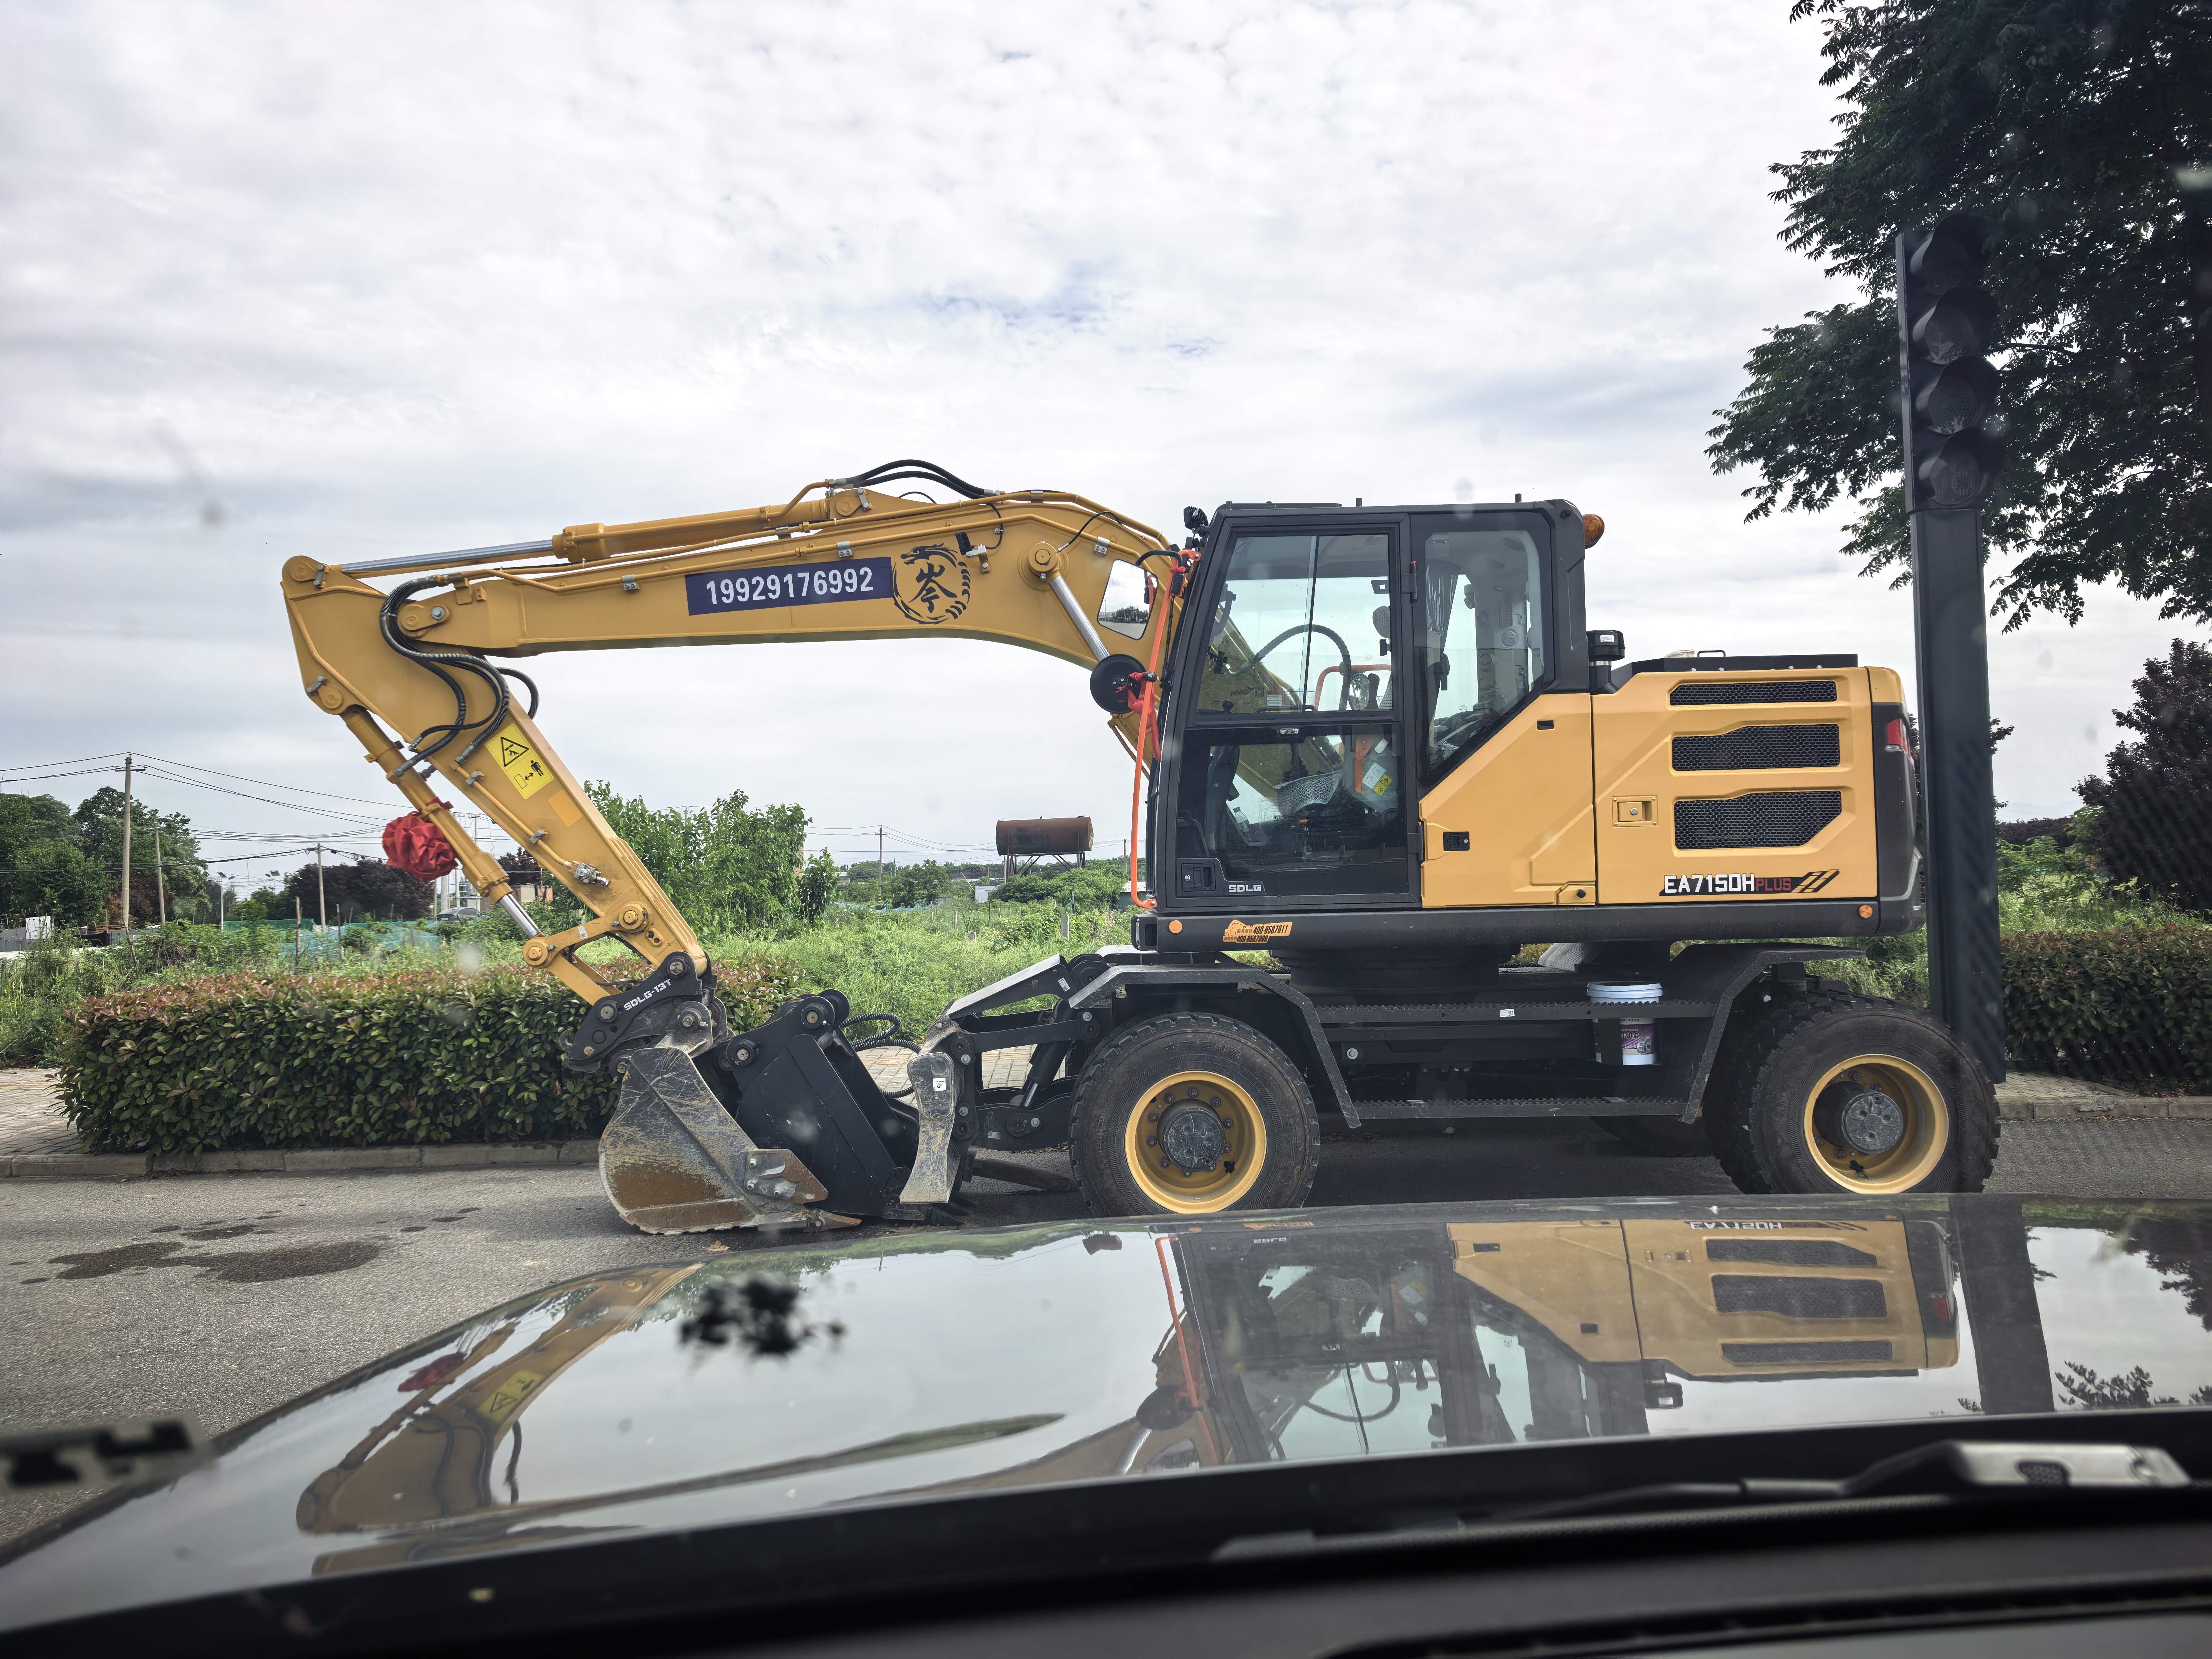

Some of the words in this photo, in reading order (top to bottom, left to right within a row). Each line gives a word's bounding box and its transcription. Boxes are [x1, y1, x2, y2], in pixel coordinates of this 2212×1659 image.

[706, 566, 874, 605] 19929176992
[1664, 873, 1755, 893] EA7150H
[1755, 878, 1791, 891] PLUS
[623, 979, 672, 1011] SDLG-13T
